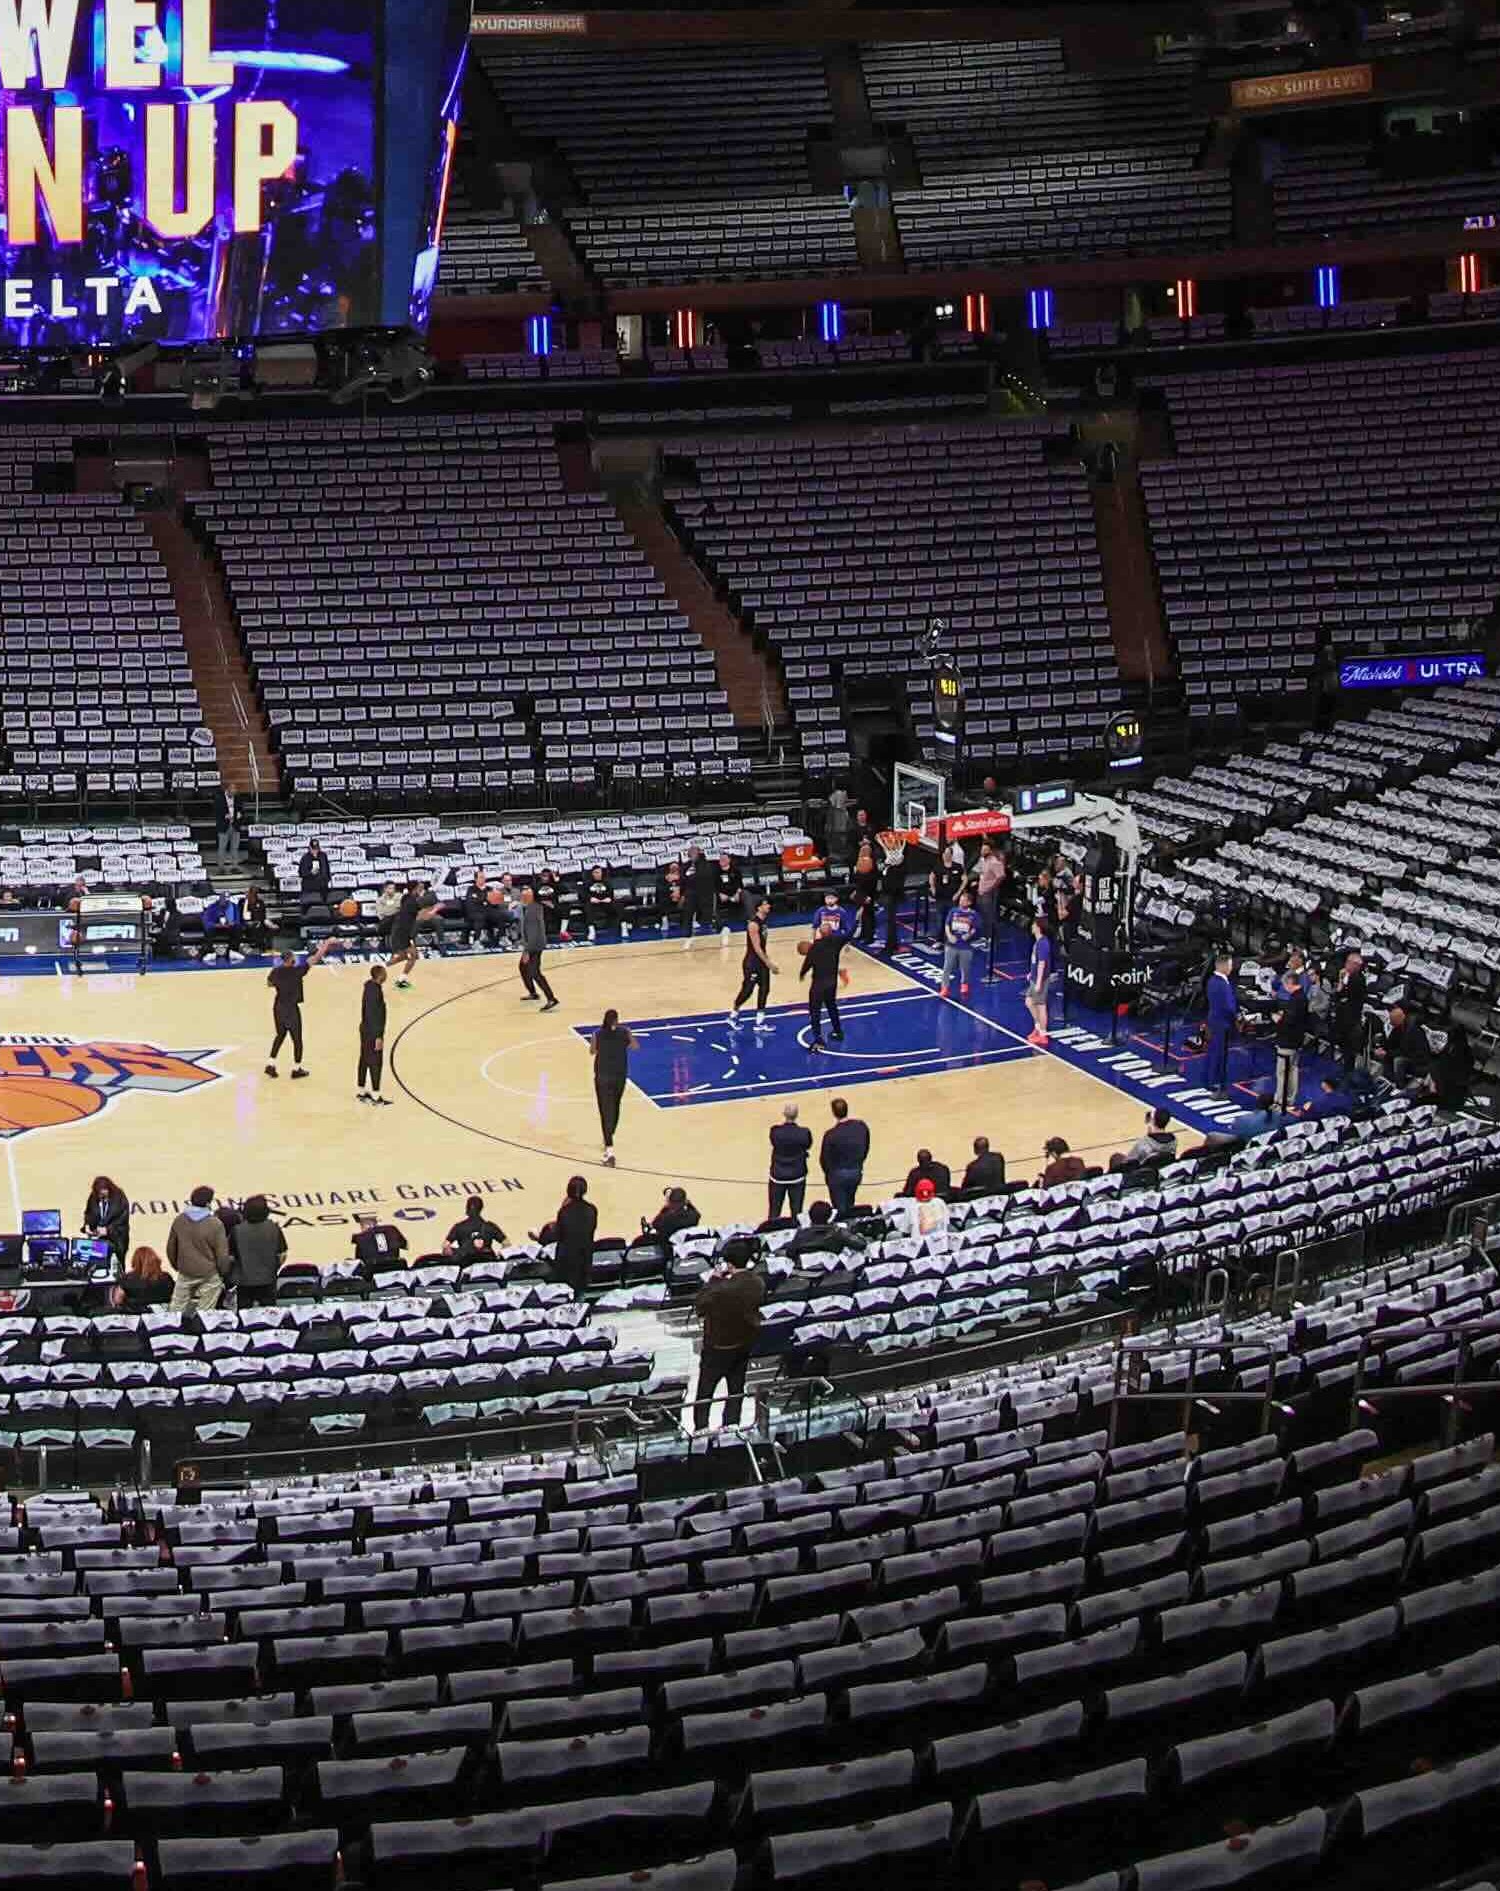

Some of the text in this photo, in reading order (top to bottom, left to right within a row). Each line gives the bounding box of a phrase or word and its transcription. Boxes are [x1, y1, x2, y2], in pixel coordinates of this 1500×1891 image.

[534, 17, 585, 30] BRIDGE
[1284, 74, 1365, 95] SUITE LEVEL
[145, 101, 299, 240] UP
[1420, 661, 1482, 678] ULTRA
[86, 924, 135, 940] ESPN
[1096, 1051, 1188, 1088] YORK
[260, 1176, 525, 1210] SQUARE GARDEN
